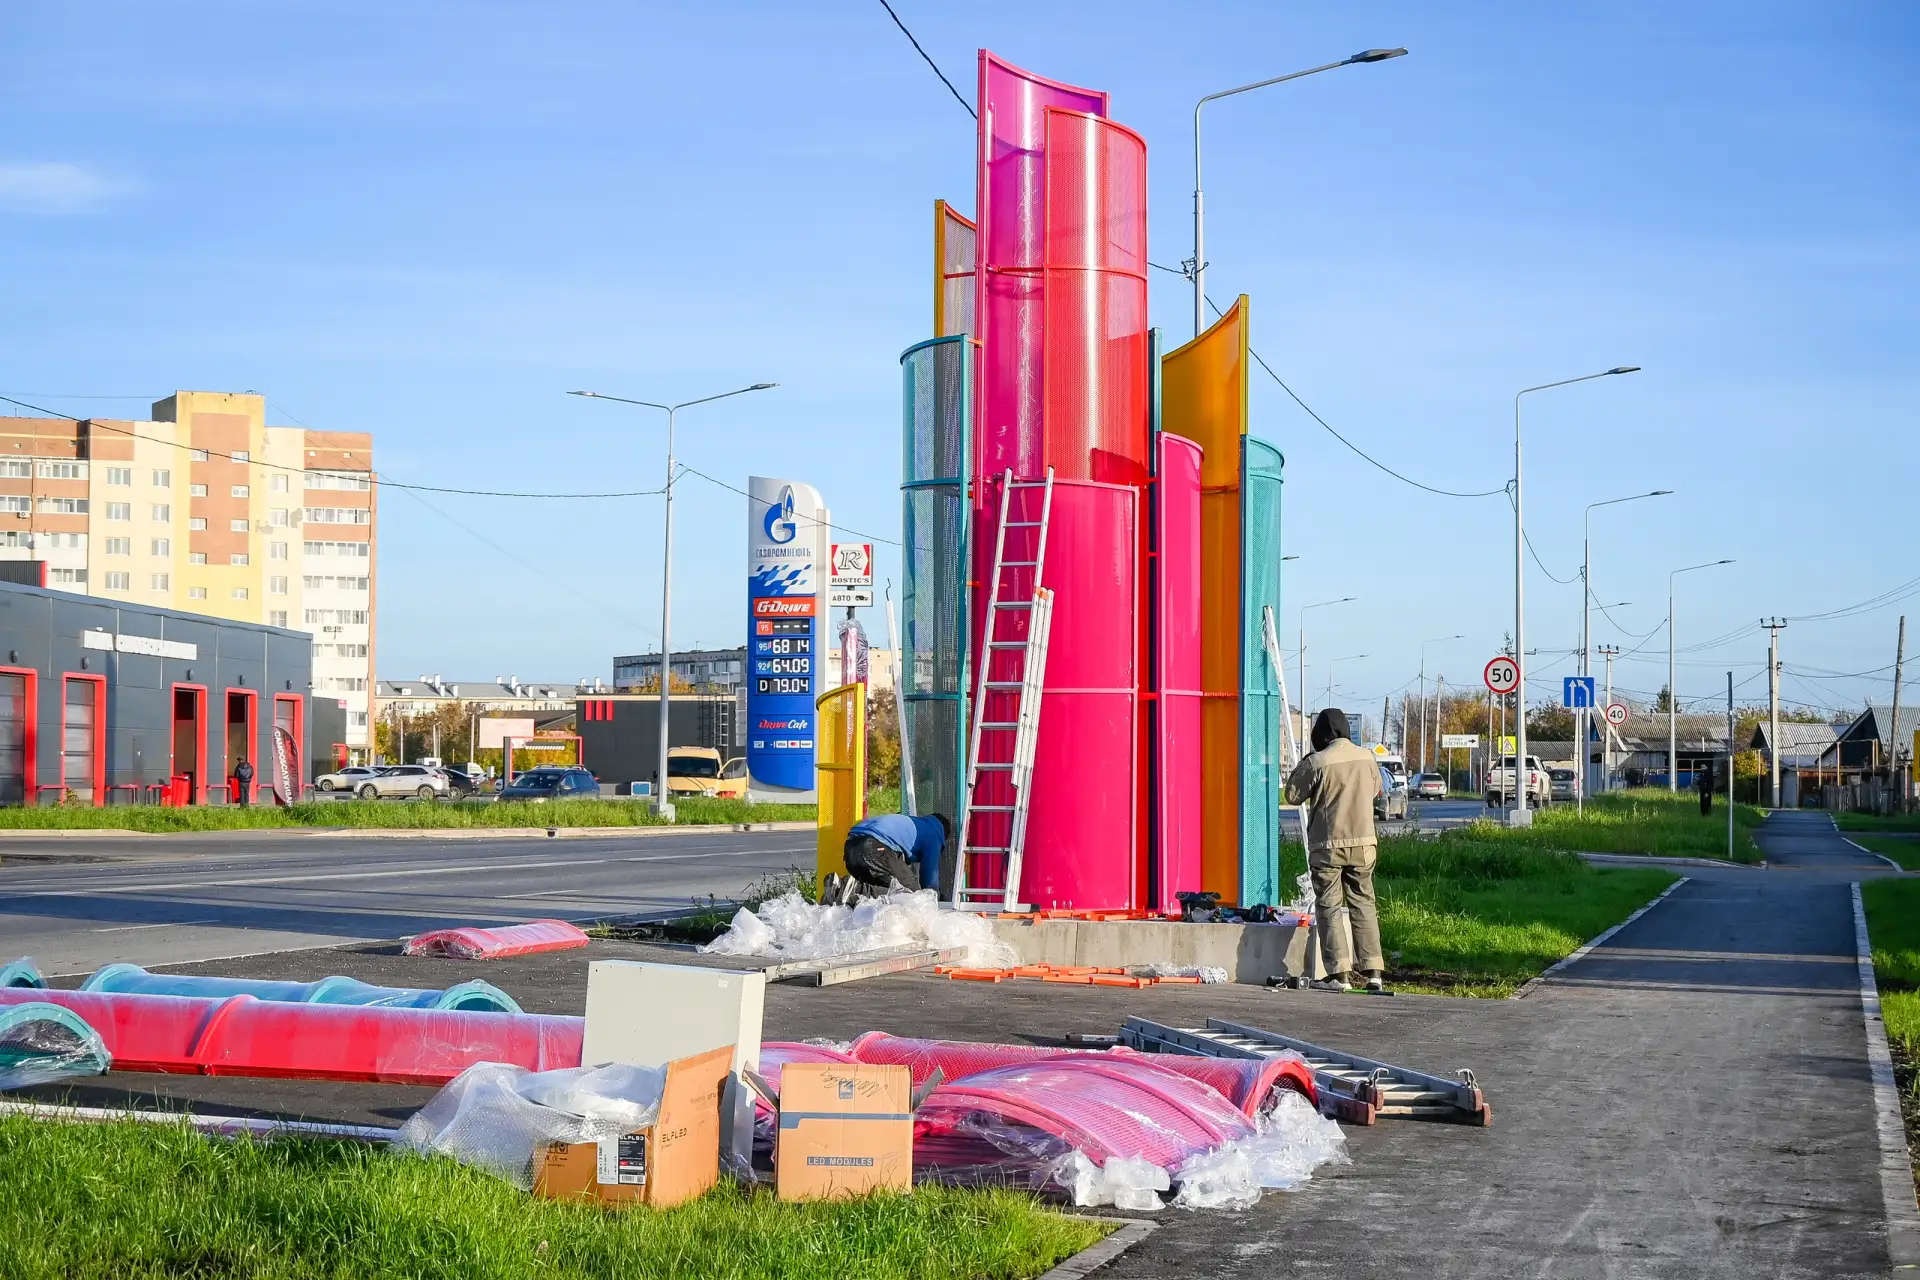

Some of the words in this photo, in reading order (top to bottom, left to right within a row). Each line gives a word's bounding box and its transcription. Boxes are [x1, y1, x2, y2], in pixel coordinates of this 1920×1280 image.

[756, 547, 811, 559] ГАЗПРОМНЕФТЬ
[832, 594, 852, 602] АВТО
[760, 624, 769, 632] 95
[758, 643, 768, 651] 95
[757, 662, 767, 671] 92
[773, 658, 809, 673] 64.09
[1491, 667, 1513, 683] 50
[760, 680, 768, 691] D
[773, 678, 809, 692] 79.04
[1609, 709, 1623, 719] 40
[808, 1157, 826, 1165] LED
[829, 1157, 873, 1166] MODULES
